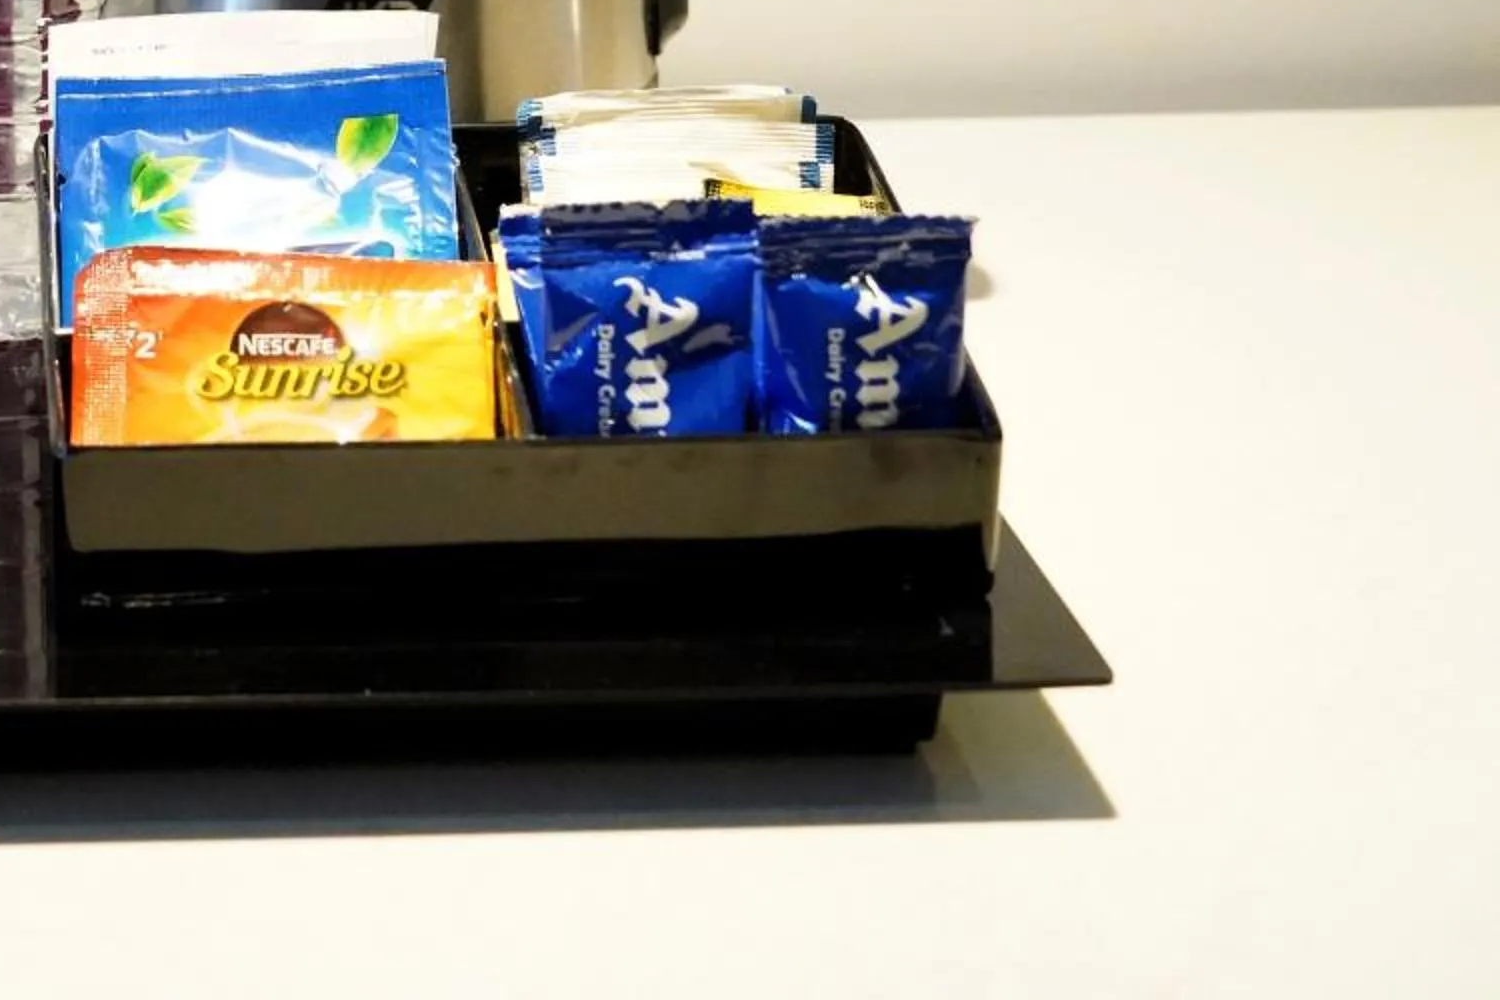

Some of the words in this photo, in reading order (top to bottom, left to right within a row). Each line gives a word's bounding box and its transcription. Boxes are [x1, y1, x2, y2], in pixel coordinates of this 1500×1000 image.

[197, 345, 405, 400] Sunrise
[593, 324, 616, 381] Dairy
[613, 276, 700, 437] Am
[824, 327, 847, 382] Dairy
